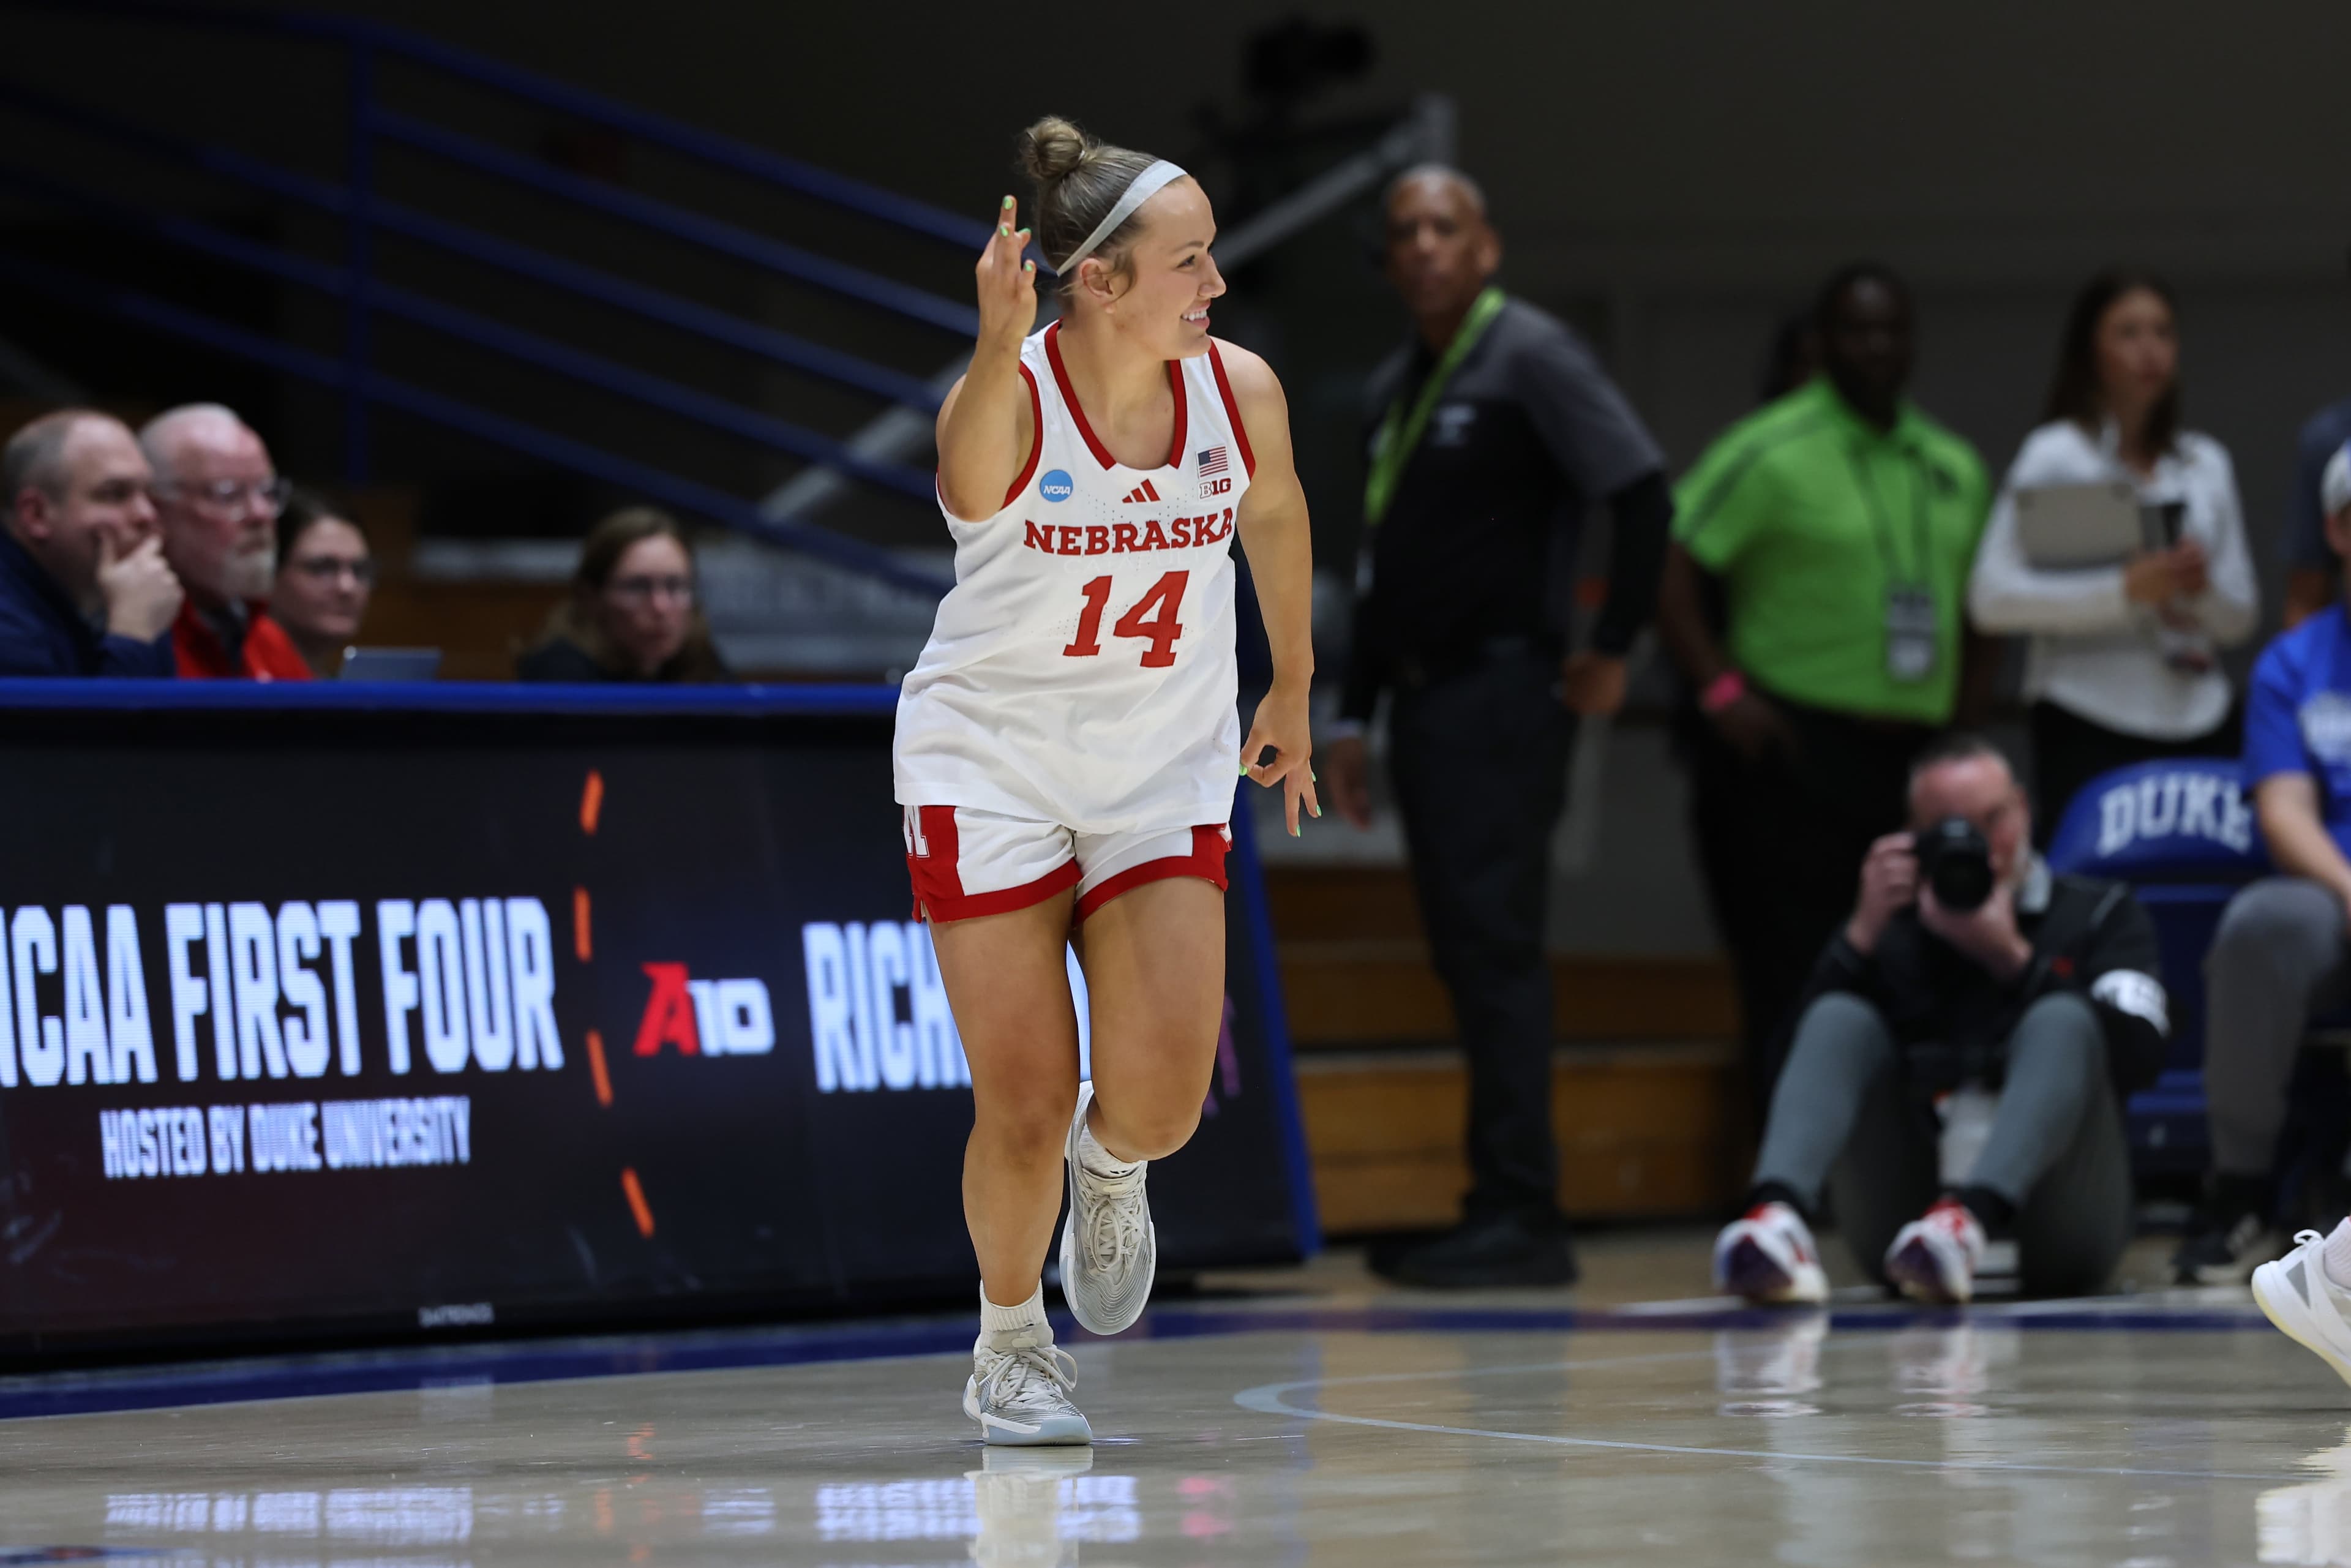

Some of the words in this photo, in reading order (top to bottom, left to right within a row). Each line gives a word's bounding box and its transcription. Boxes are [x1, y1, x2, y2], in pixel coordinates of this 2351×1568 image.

[1024, 508, 1233, 555] NEBRASKA
[1043, 485, 1070, 495] NCAA
[1063, 570, 1190, 667] 14
[2096, 771, 2252, 857] DUKE
[165, 900, 362, 1082] FIRST
[377, 896, 565, 1076] FOUR
[801, 920, 973, 1093] RICH
[100, 1106, 207, 1179] HOSTED
[209, 1105, 245, 1174] BY
[249, 1101, 322, 1173] DUKE
[321, 1095, 470, 1171] UNIVERSITY
